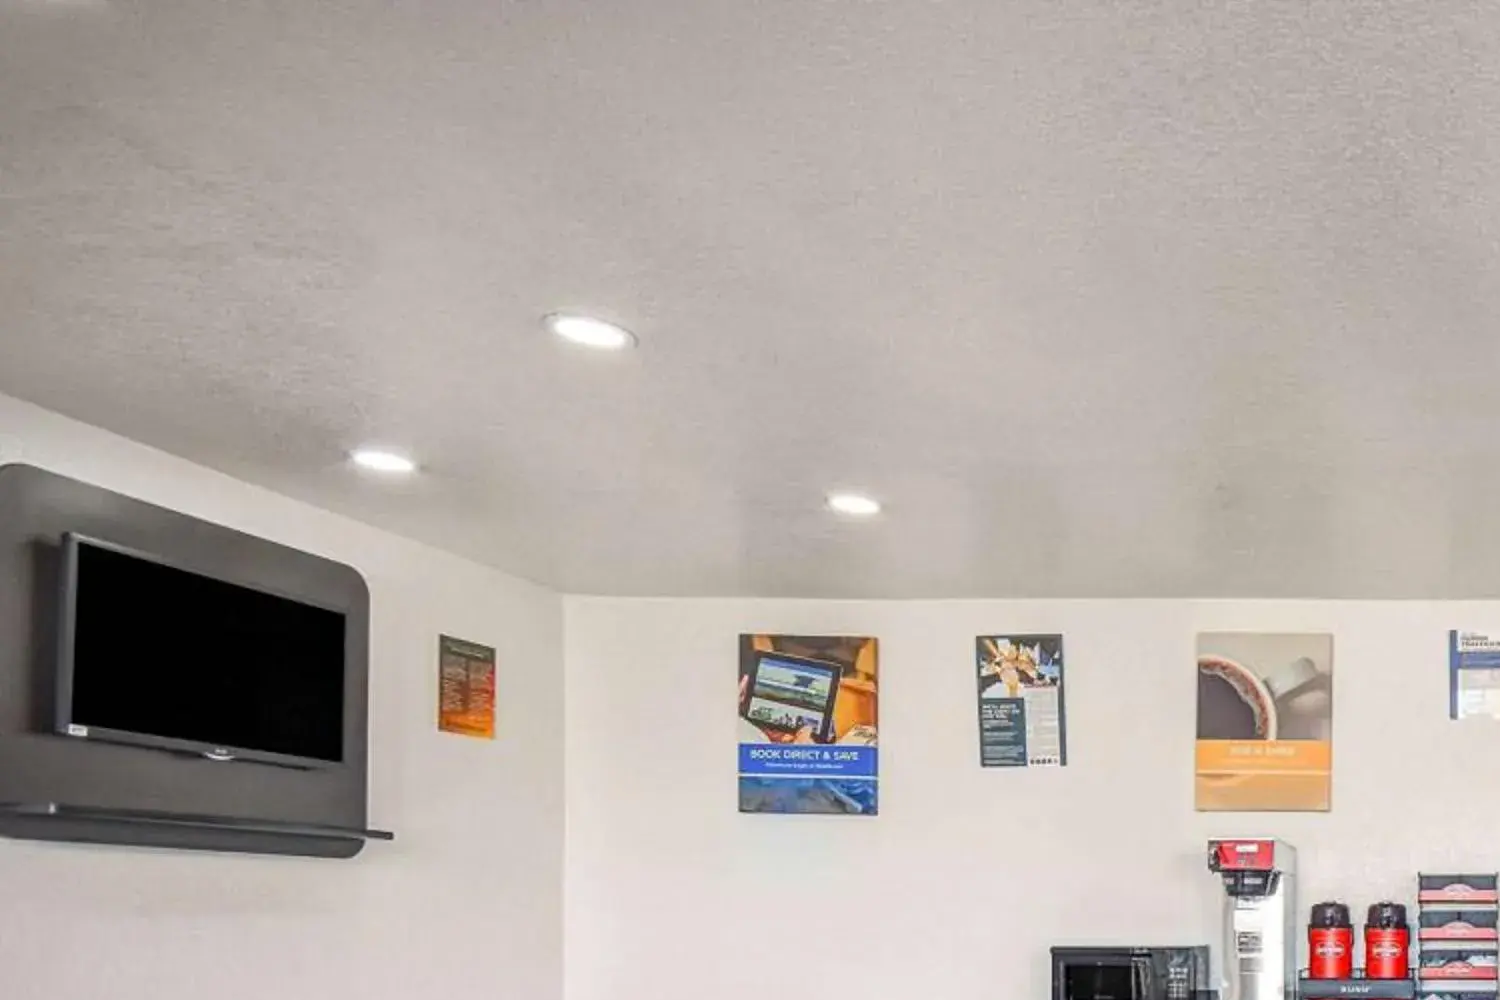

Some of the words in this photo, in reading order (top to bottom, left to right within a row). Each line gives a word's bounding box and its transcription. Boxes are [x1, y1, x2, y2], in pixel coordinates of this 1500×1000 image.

[750, 749, 781, 760] BOOK
[783, 749, 820, 761] DIRECT
[834, 751, 860, 761] SAVE
